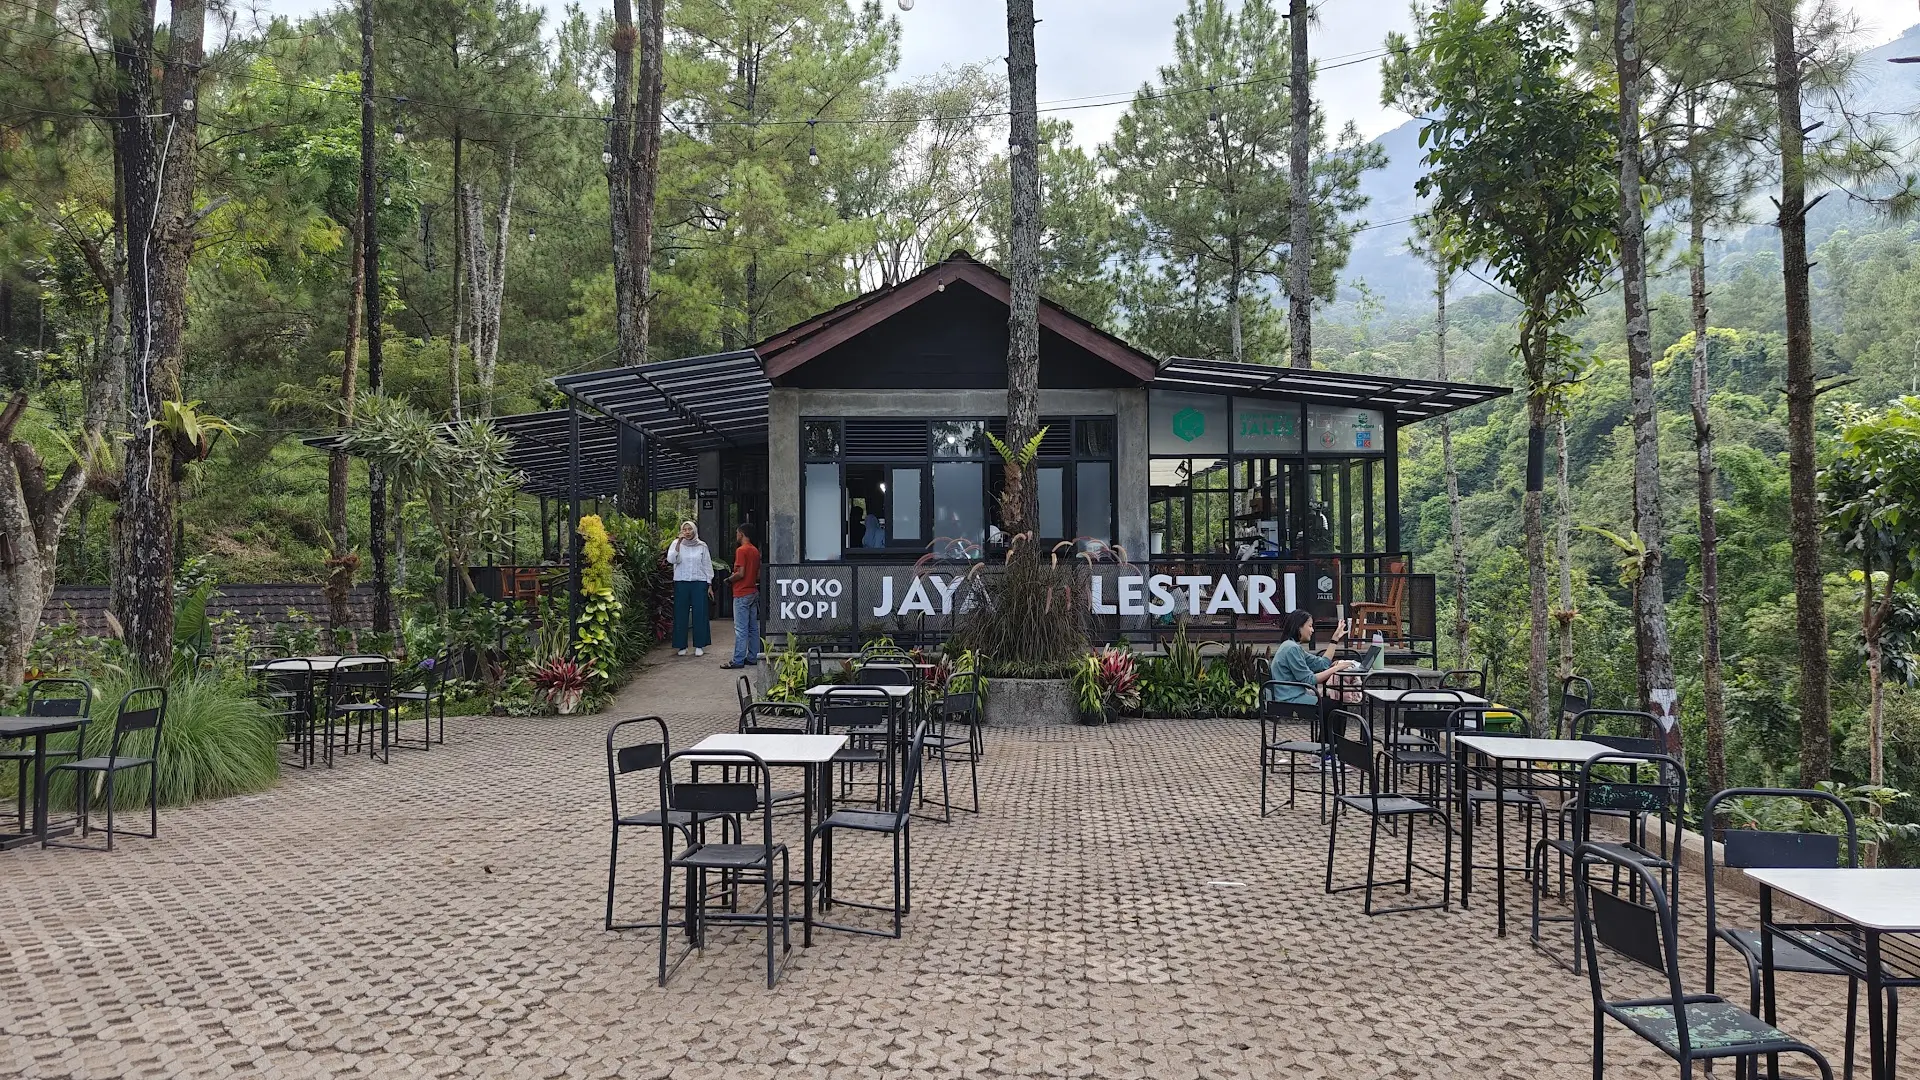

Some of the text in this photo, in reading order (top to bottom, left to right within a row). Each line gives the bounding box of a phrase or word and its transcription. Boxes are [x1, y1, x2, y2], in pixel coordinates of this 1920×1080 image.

[777, 578, 843, 597] TOKO
[873, 573, 1297, 617] JAYA LESTARI
[780, 601, 837, 620] KOPI
